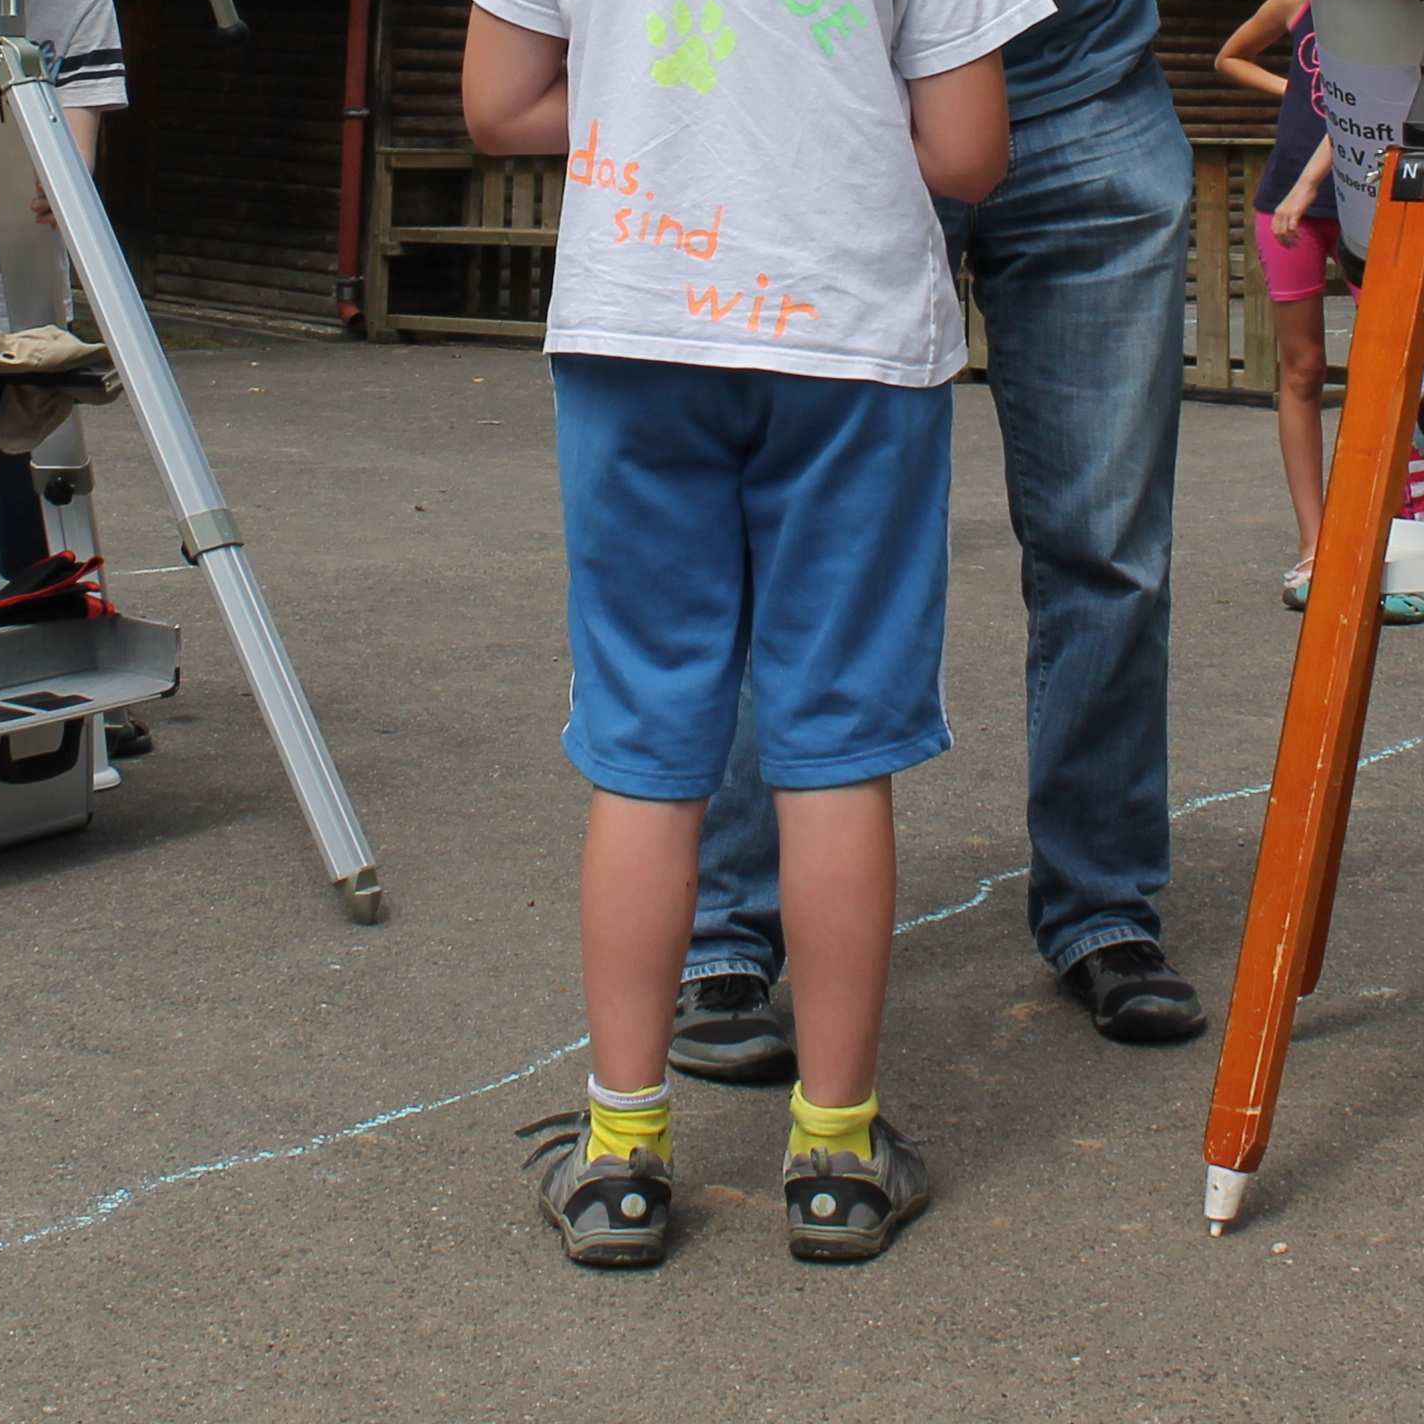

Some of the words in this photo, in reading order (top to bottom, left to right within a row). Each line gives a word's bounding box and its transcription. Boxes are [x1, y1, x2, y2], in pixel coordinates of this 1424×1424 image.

[1402, 162, 1419, 179] N
[612, 189, 724, 262] sind
[685, 271, 822, 338] wir
